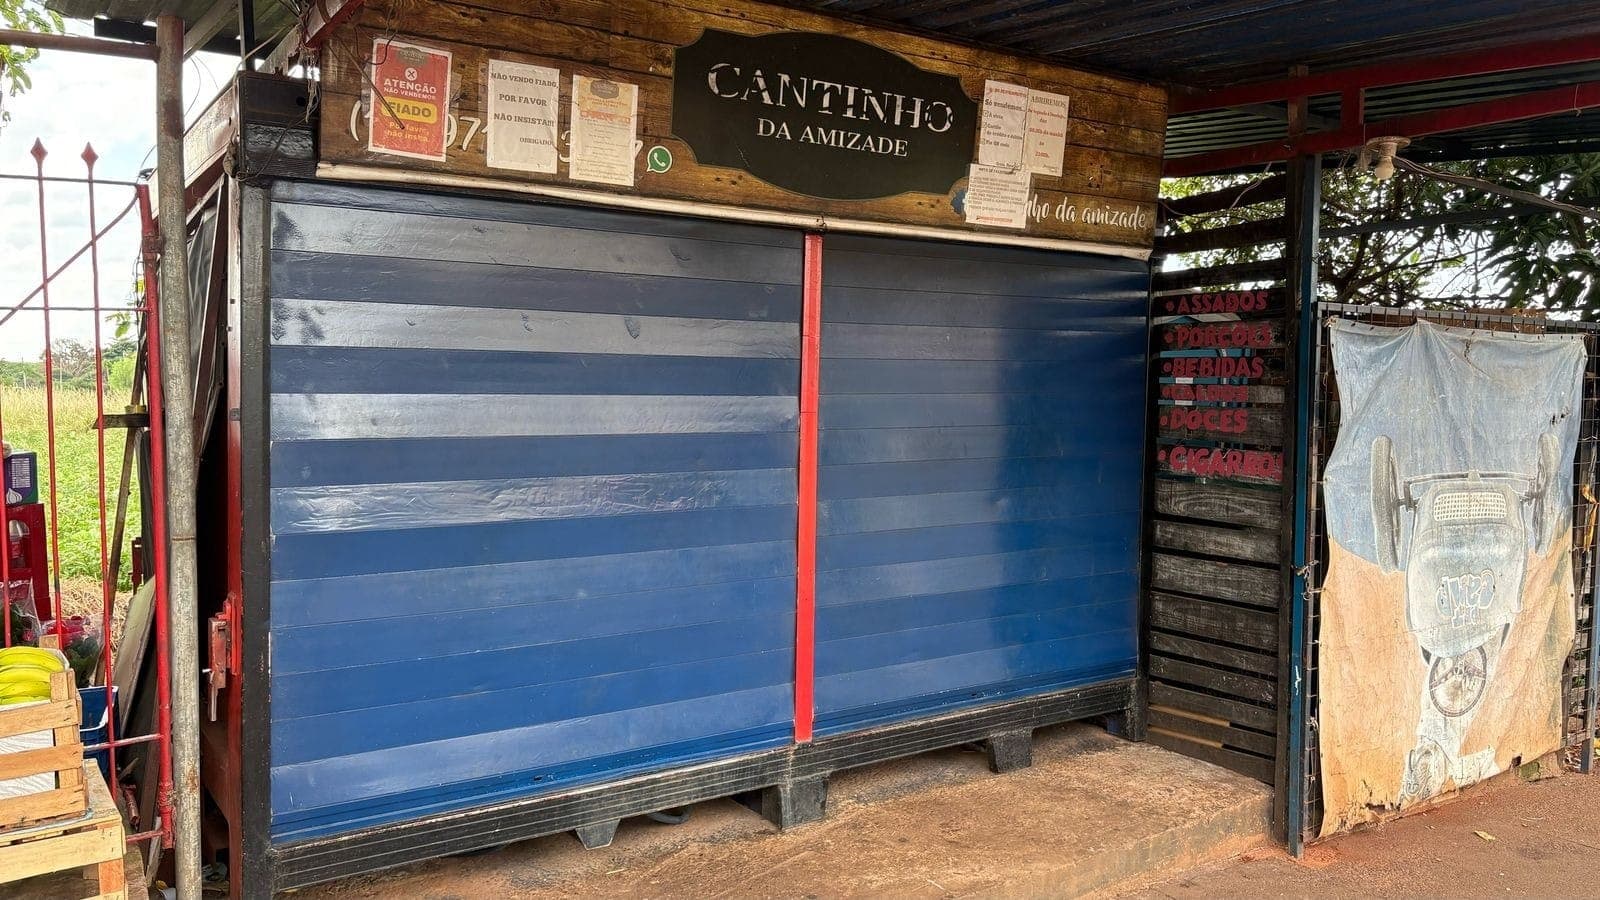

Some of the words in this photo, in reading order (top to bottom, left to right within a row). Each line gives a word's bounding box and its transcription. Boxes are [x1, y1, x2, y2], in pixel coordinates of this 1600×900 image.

[383, 78, 437, 94] ATENÇÃO
[490, 72, 508, 81] NÃO
[509, 74, 534, 84] VENDO
[498, 93, 516, 102] POR
[518, 96, 547, 107] FAVOR
[707, 63, 953, 132] CANTINHO
[493, 112, 513, 122] NÃO
[757, 118, 792, 141] DA
[799, 125, 909, 157] AMIZADE
[1055, 196, 1077, 222] da
[1081, 205, 1147, 230] amizade
[1177, 291, 1269, 314] ASSADOS
[1172, 356, 1265, 378] BEBIDAS
[1169, 407, 1249, 434] DOCES
